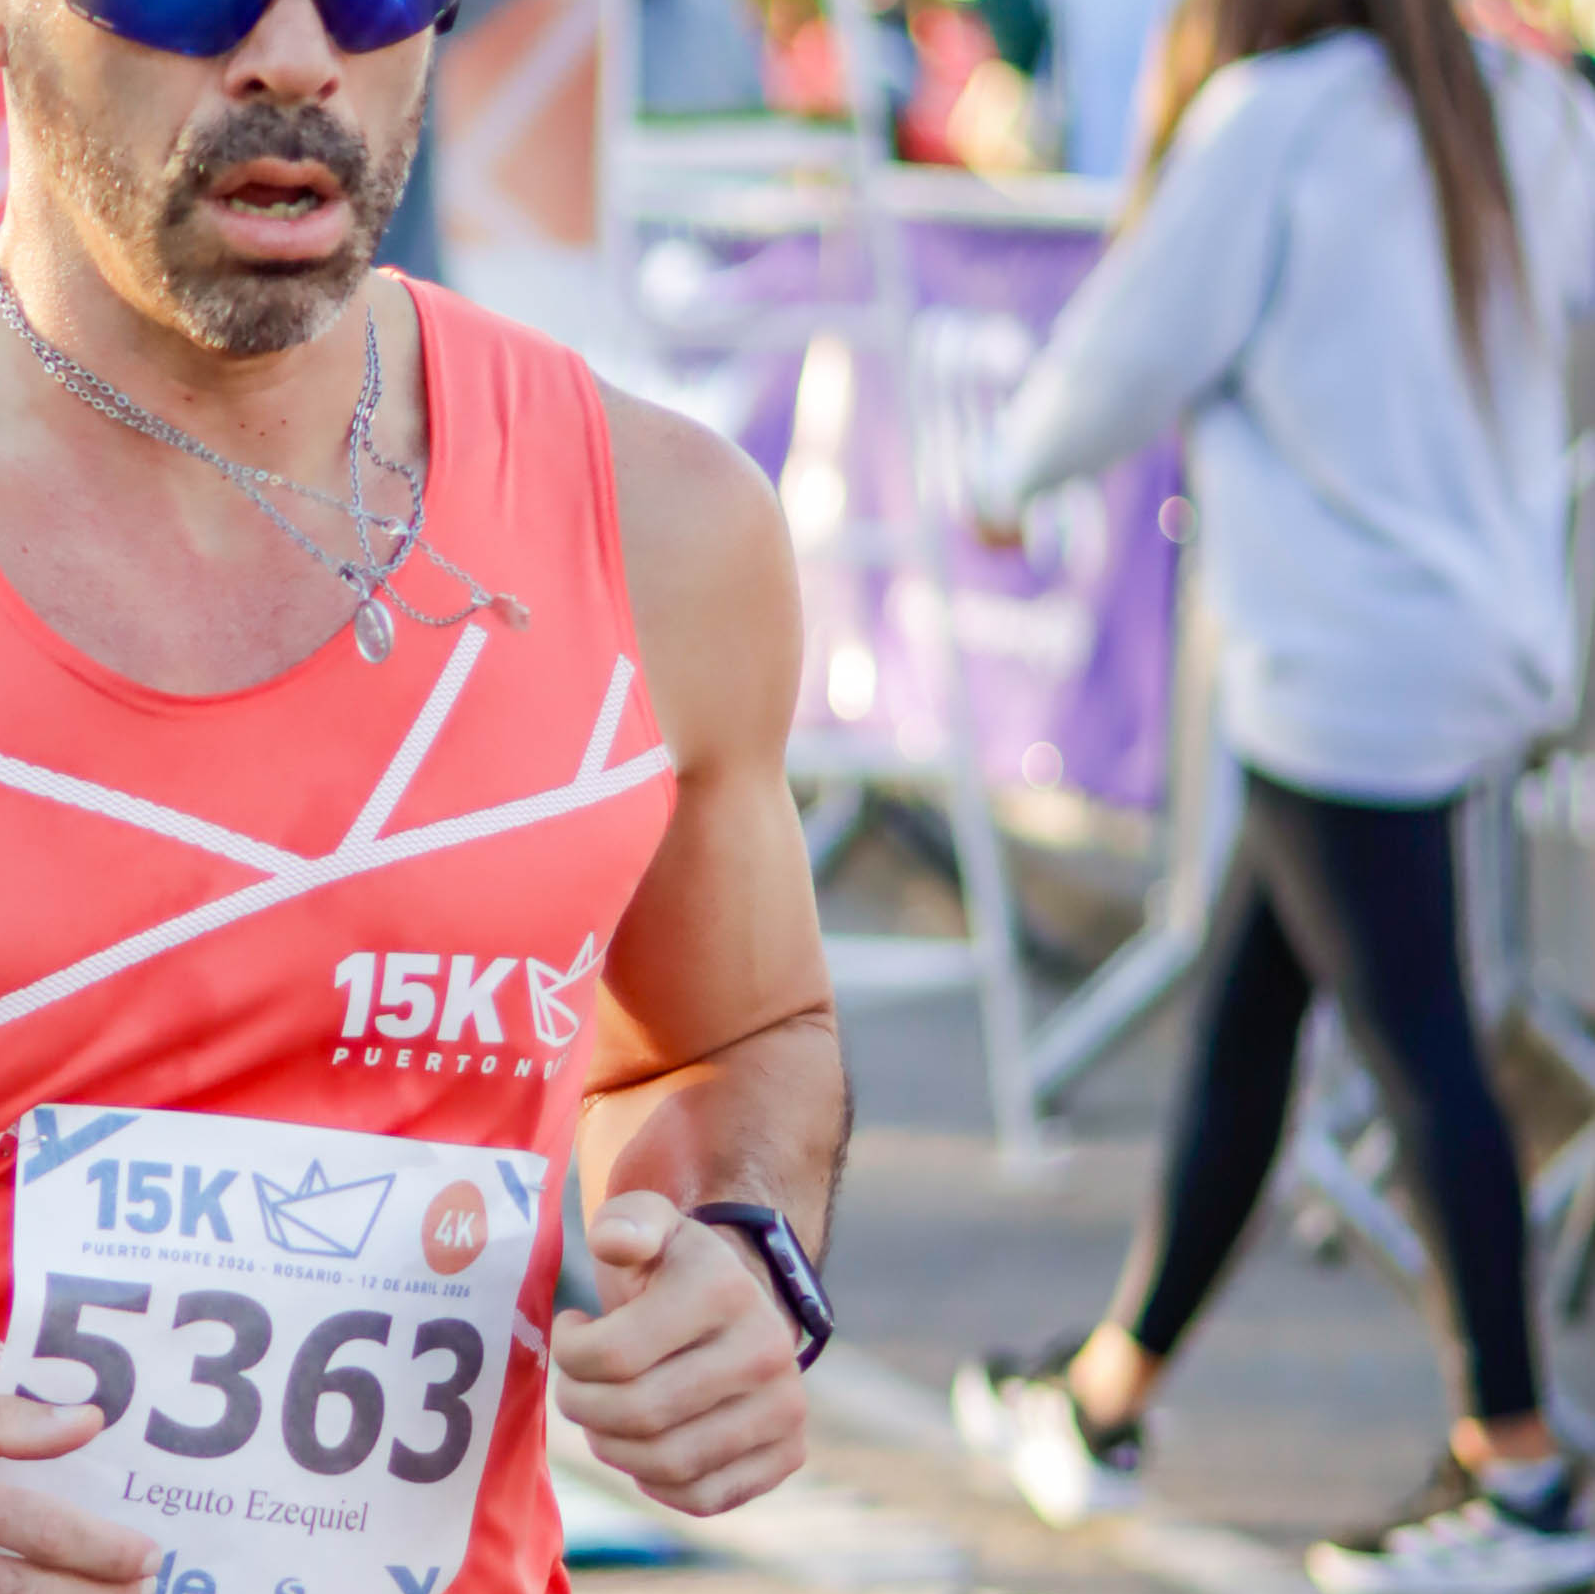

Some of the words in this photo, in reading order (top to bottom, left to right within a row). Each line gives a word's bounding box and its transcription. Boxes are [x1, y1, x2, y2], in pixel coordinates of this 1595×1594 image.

[334, 951, 519, 1043] 15K
[86, 1157, 240, 1243] 15K
[434, 1209, 477, 1248] 4K
[81, 1241, 152, 1259] PUERTO
[158, 1247, 211, 1266] NORTE
[217, 1255, 255, 1272] 2026
[272, 1263, 342, 1284] ROSARIO
[382, 1277, 400, 1292] DE
[405, 1279, 438, 1295] ABRIL
[15, 1271, 484, 1485] 5363
[120, 1470, 235, 1516] Leguto
[243, 1488, 370, 1536] Ezequiel
